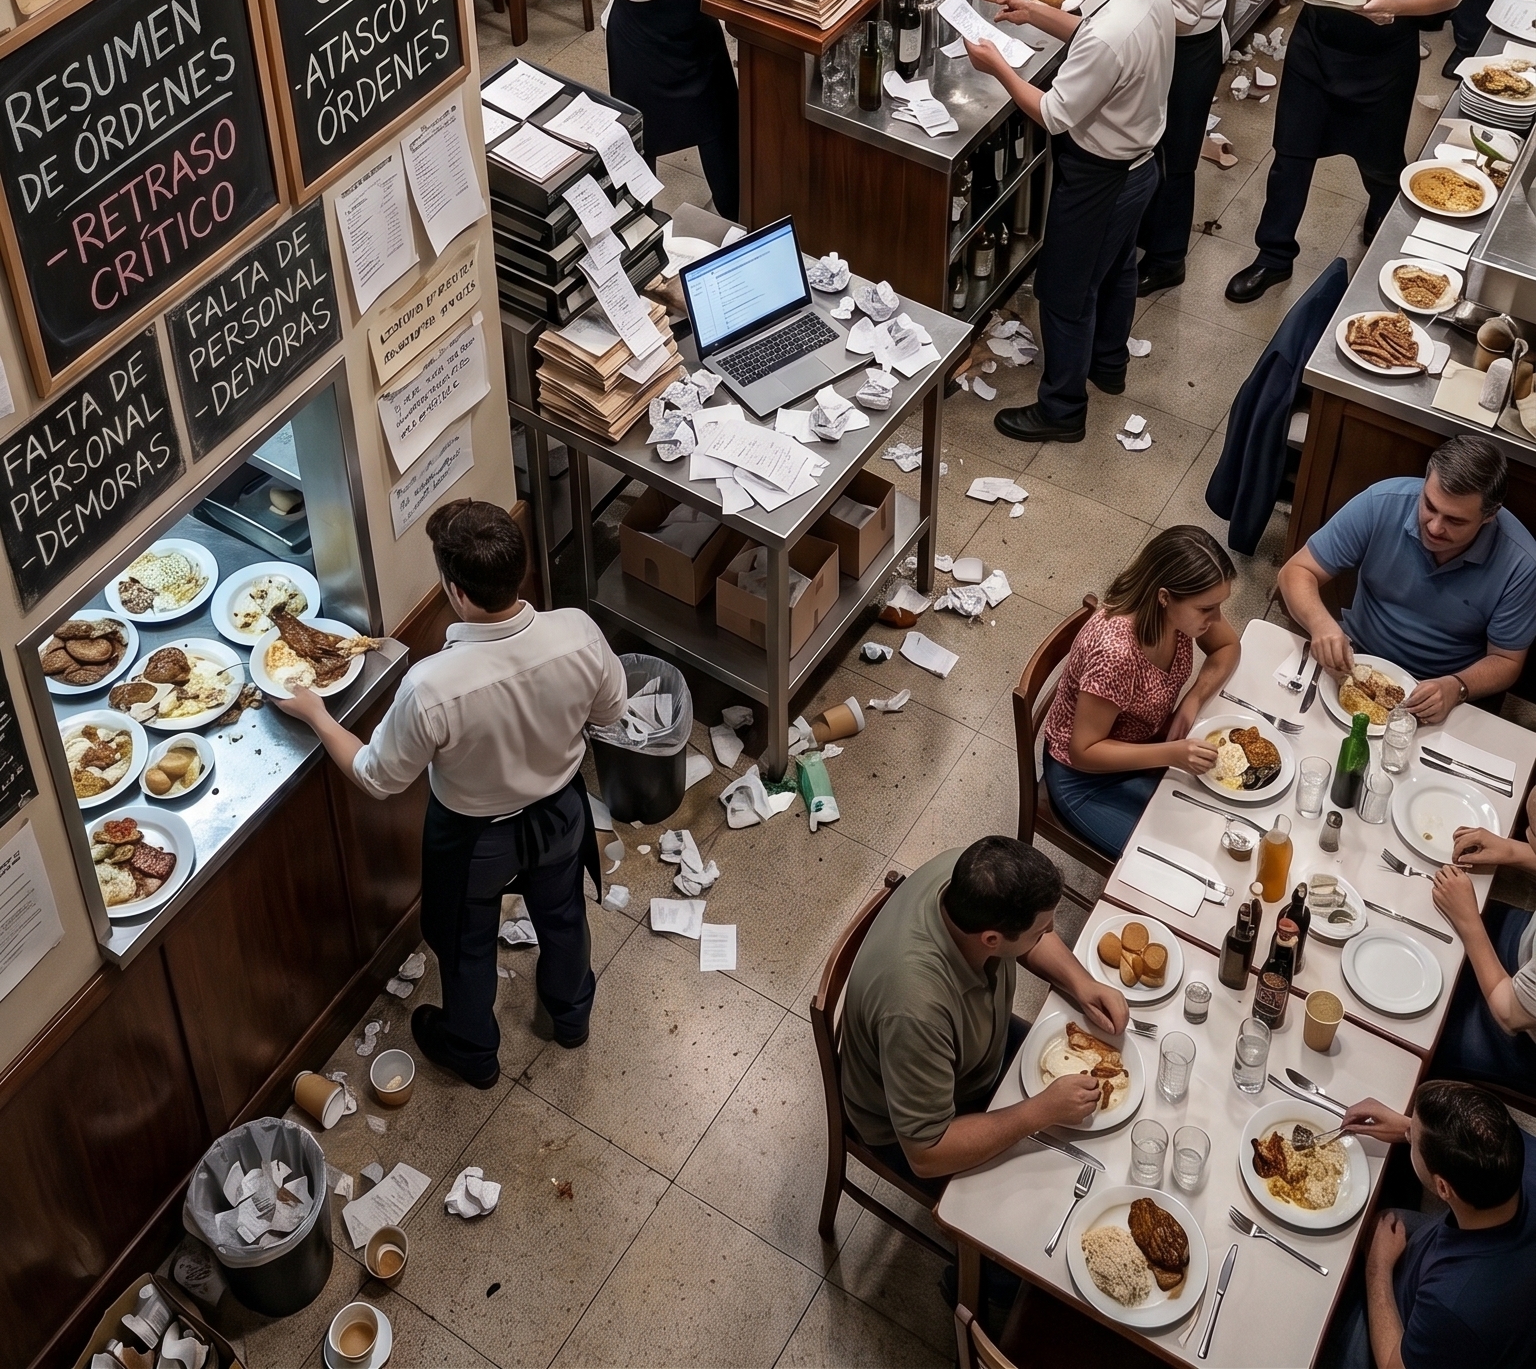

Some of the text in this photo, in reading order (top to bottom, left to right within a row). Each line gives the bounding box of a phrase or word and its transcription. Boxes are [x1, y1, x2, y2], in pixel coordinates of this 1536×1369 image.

[17, 37, 236, 214] DE ÓRDENES
[317, 19, 450, 146] ÓRDENES
[90, 181, 235, 311] CRÍTICO
[186, 222, 312, 339] FALTA DE
[188, 257, 327, 383] PERSONAL
[2, 350, 148, 487] FALTA DE
[9, 393, 164, 532] PERSONAL
